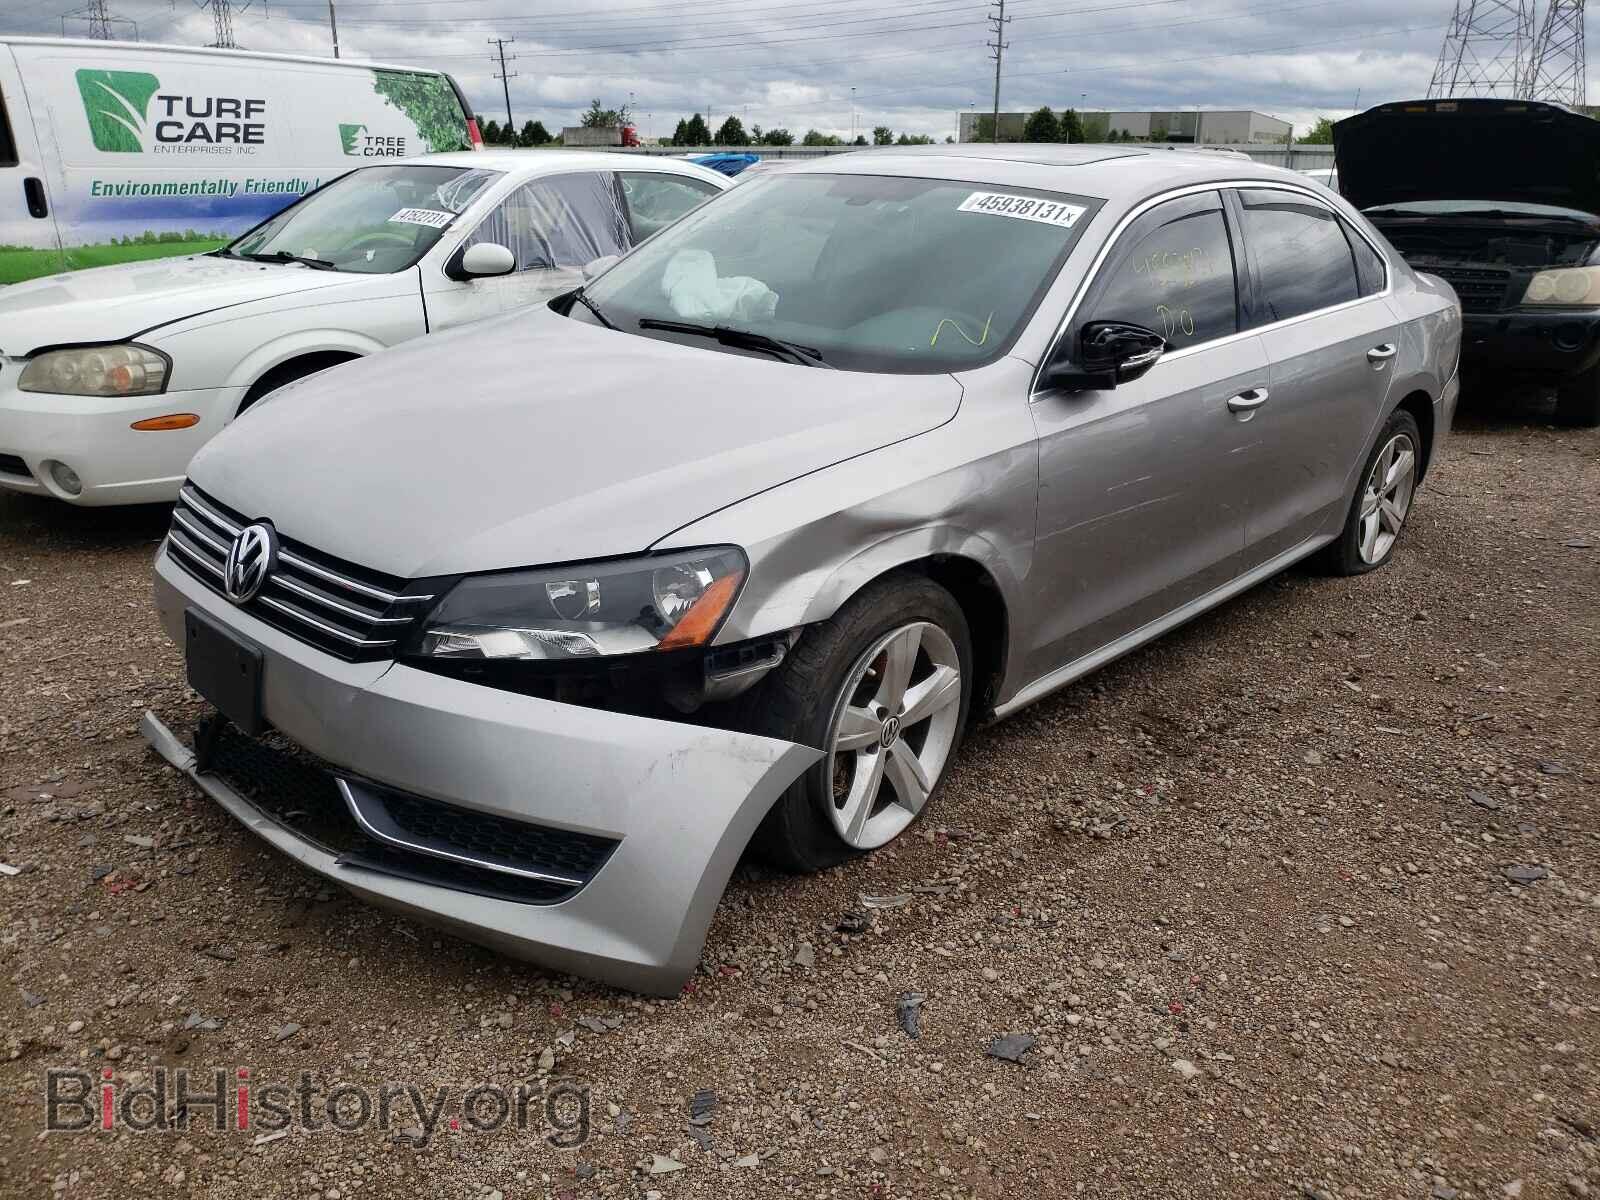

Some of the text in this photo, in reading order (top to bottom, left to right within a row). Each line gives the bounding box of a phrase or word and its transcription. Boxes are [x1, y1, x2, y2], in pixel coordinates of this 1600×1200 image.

[157, 95, 265, 119] TURF
[155, 121, 265, 144] CARE
[153, 144, 256, 155] ENTERPRISES INC
[364, 136, 406, 147] TREE
[363, 147, 406, 157] CARE
[91, 179, 238, 198] Environmentally
[244, 177, 309, 195] Friendly
